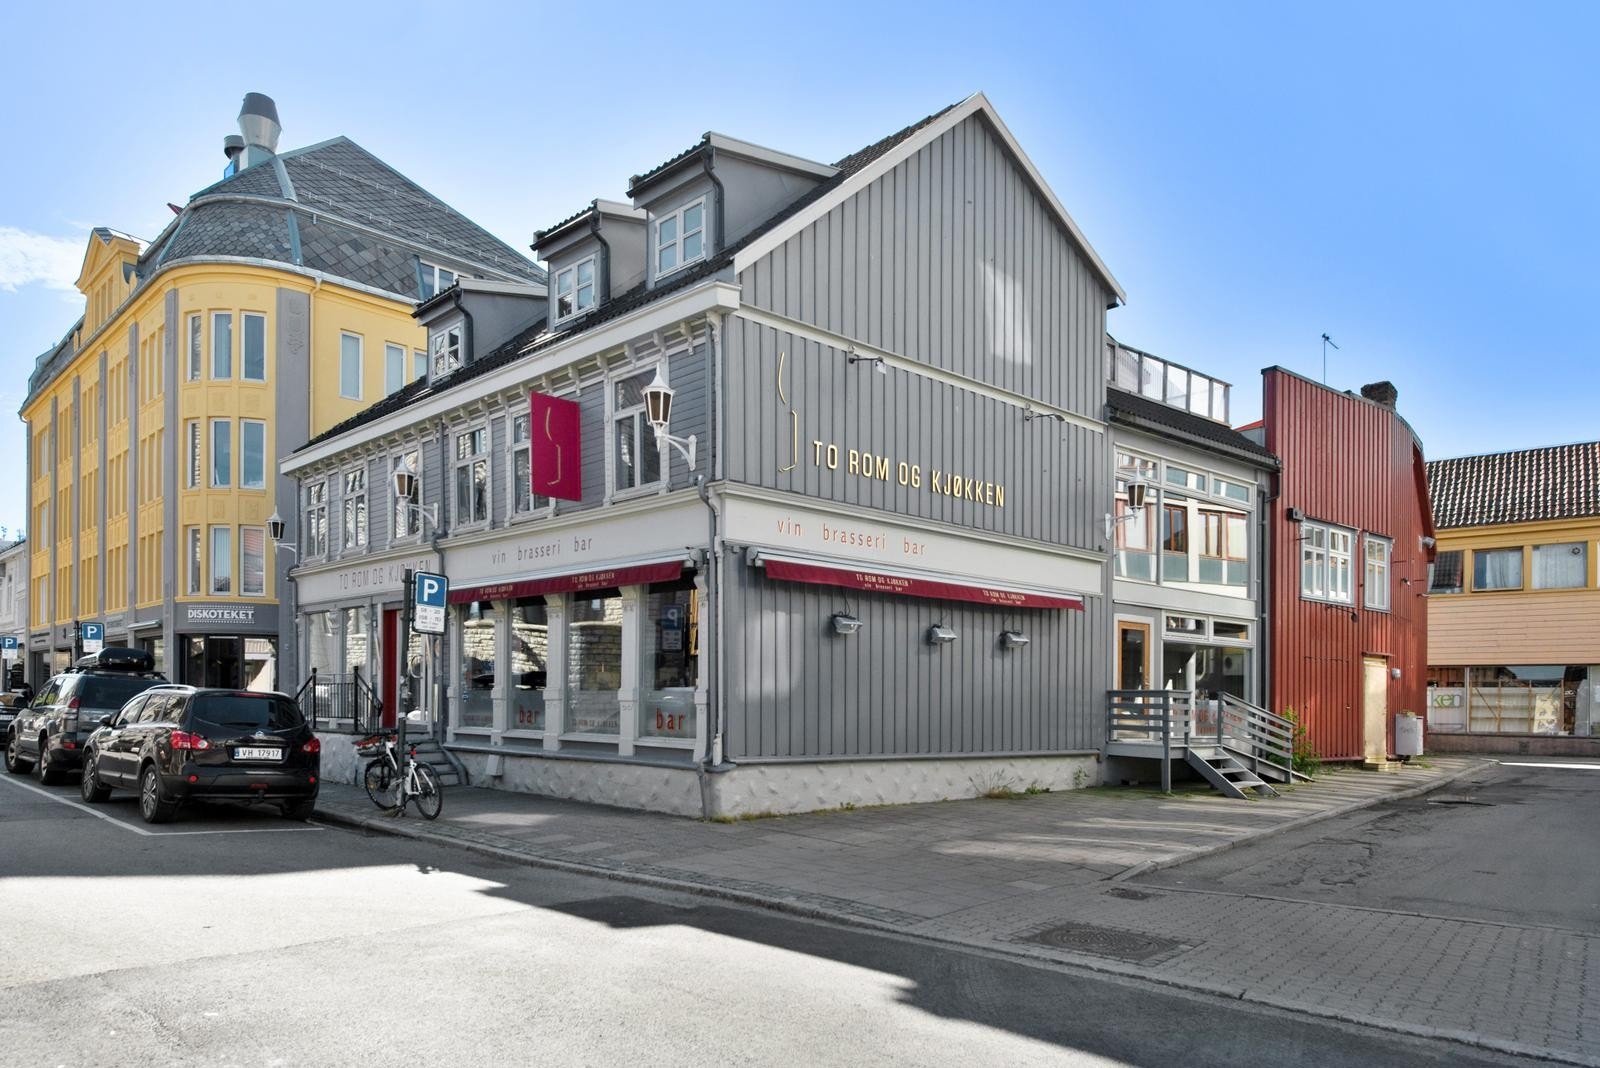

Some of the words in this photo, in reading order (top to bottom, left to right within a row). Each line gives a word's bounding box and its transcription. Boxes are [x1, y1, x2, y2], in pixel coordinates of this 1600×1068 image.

[813, 440, 838, 469] TO
[848, 449, 889, 481] ROM
[898, 461, 921, 488] OG
[931, 469, 1004, 507] KJØKKEN
[777, 517, 802, 537] vin
[823, 523, 887, 550] brasseri
[903, 537, 925, 555] bar
[492, 551, 506, 564] vin
[517, 540, 560, 561] brasseri
[574, 536, 592, 552] bar
[339, 573, 349, 590] TO
[424, 579, 438, 602] P
[187, 609, 254, 619] DISKOTEKET
[87, 625, 97, 638] P
[5, 638, 13, 648] P
[518, 704, 540, 723] bar
[656, 707, 686, 731] bar
[257, 749, 280, 757] 17917
